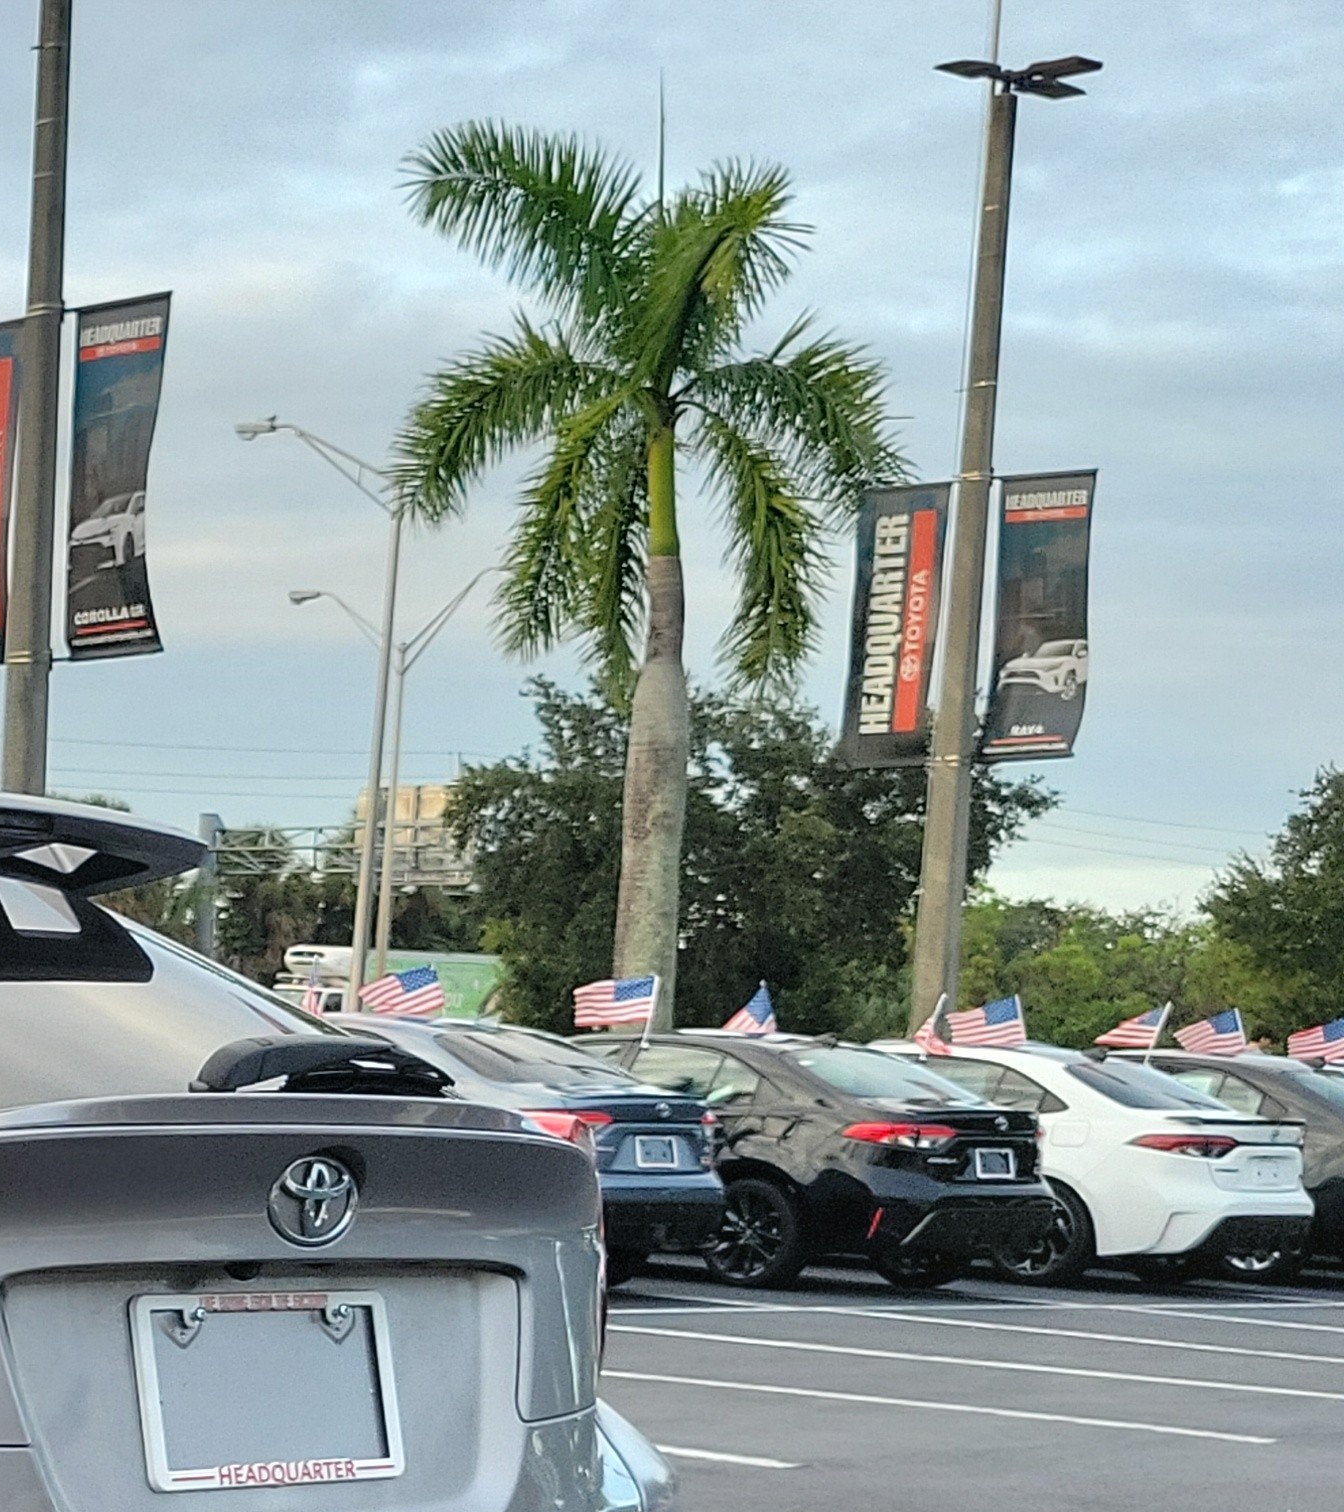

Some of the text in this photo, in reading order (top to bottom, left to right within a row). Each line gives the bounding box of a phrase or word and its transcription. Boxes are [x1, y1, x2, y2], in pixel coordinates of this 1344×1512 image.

[74, 606, 130, 625] COROLLA
[859, 513, 910, 735] HEADQUARTER
[904, 570, 930, 654] TOYOTA
[218, 1460, 356, 1486] HEADQUARTER
